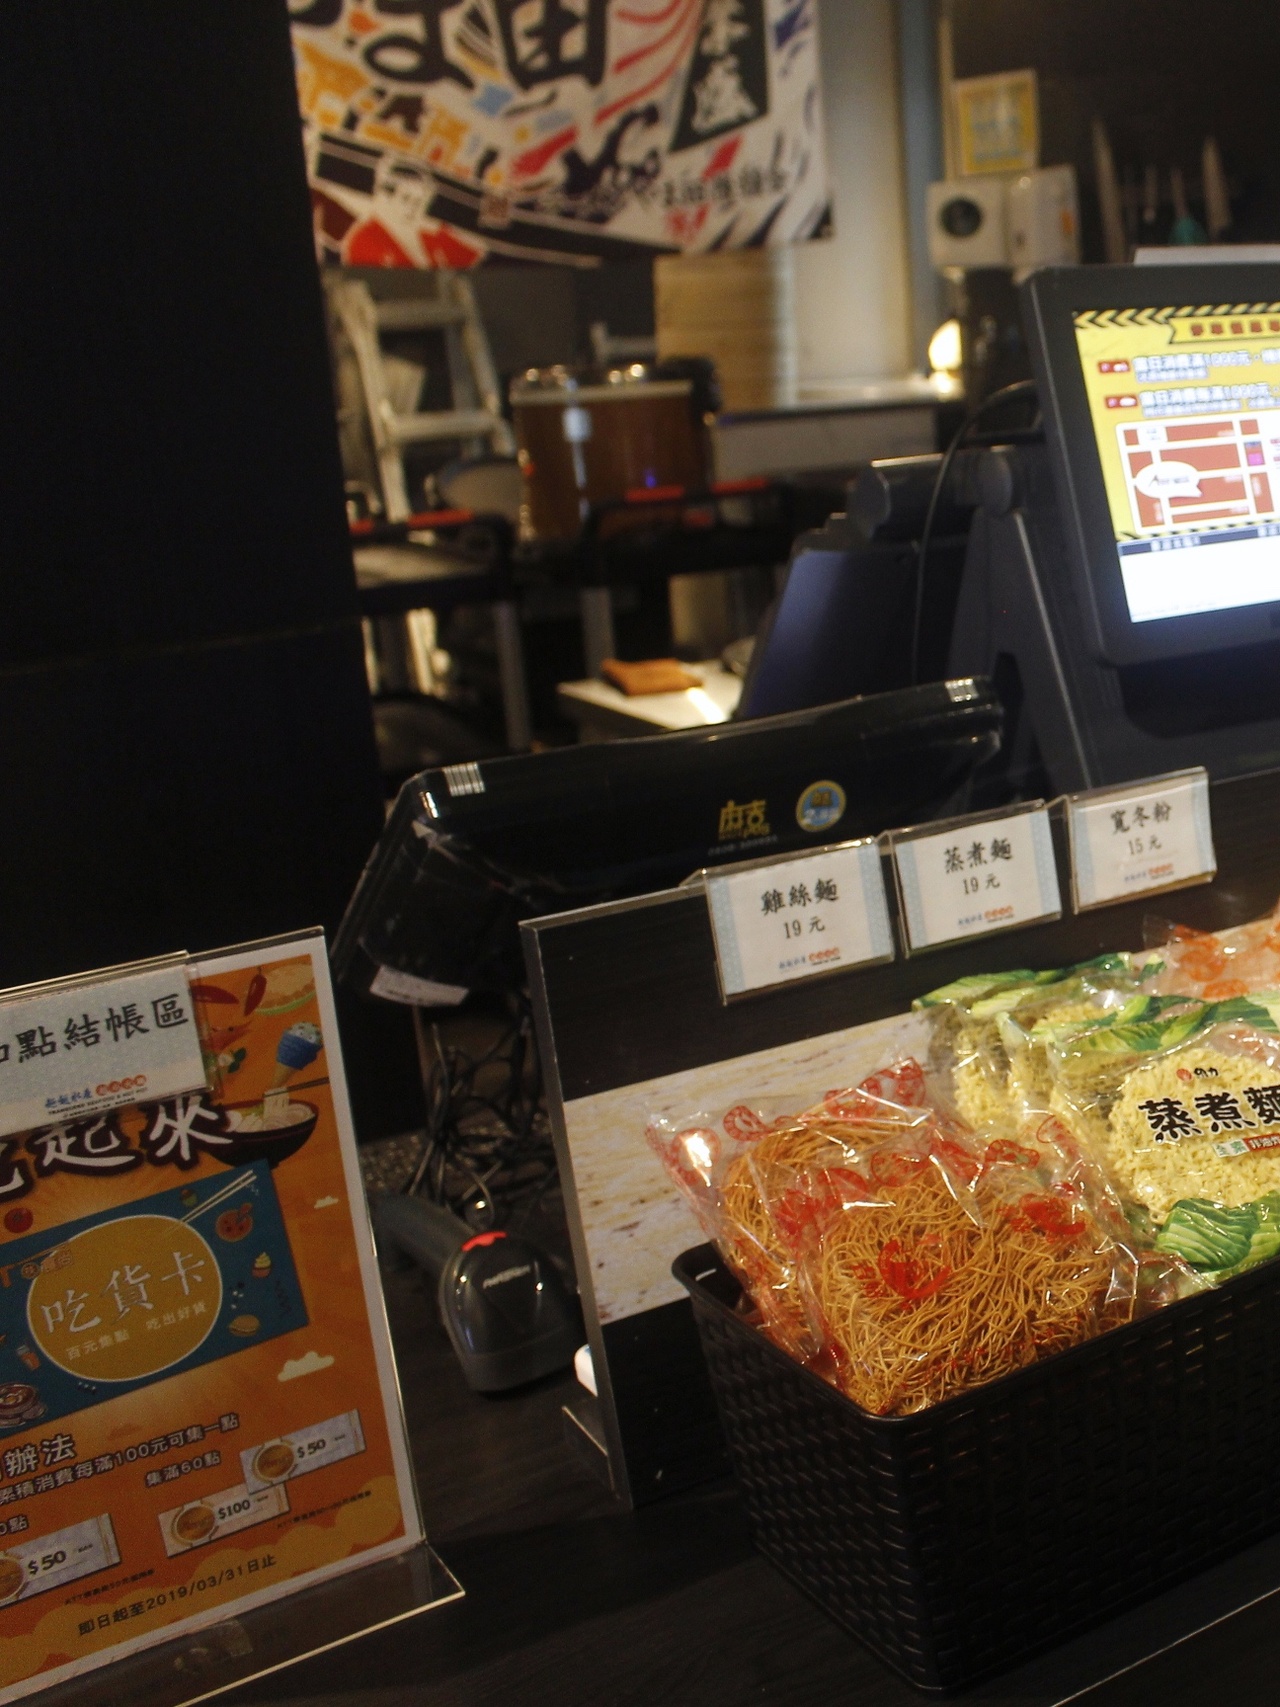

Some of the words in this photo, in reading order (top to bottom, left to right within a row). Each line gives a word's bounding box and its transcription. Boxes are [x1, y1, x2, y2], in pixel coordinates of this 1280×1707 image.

[1110, 800, 1172, 835] 寬冬粉
[943, 836, 1014, 875] 蒸煮麵
[760, 877, 840, 917] 雞絲麵
[962, 873, 1001, 896] 19元
[783, 915, 826, 940] 19元
[40, 1251, 205, 1334] 吃貨卡
[0, 1432, 76, 1479] 辦法
[296, 1438, 326, 1460] $50
[145, 1450, 222, 1488] 集滿60點
[217, 1498, 251, 1521] $100
[27, 1549, 67, 1576] $50
[77, 1553, 278, 1637] 即日起至2019/03/31日止
